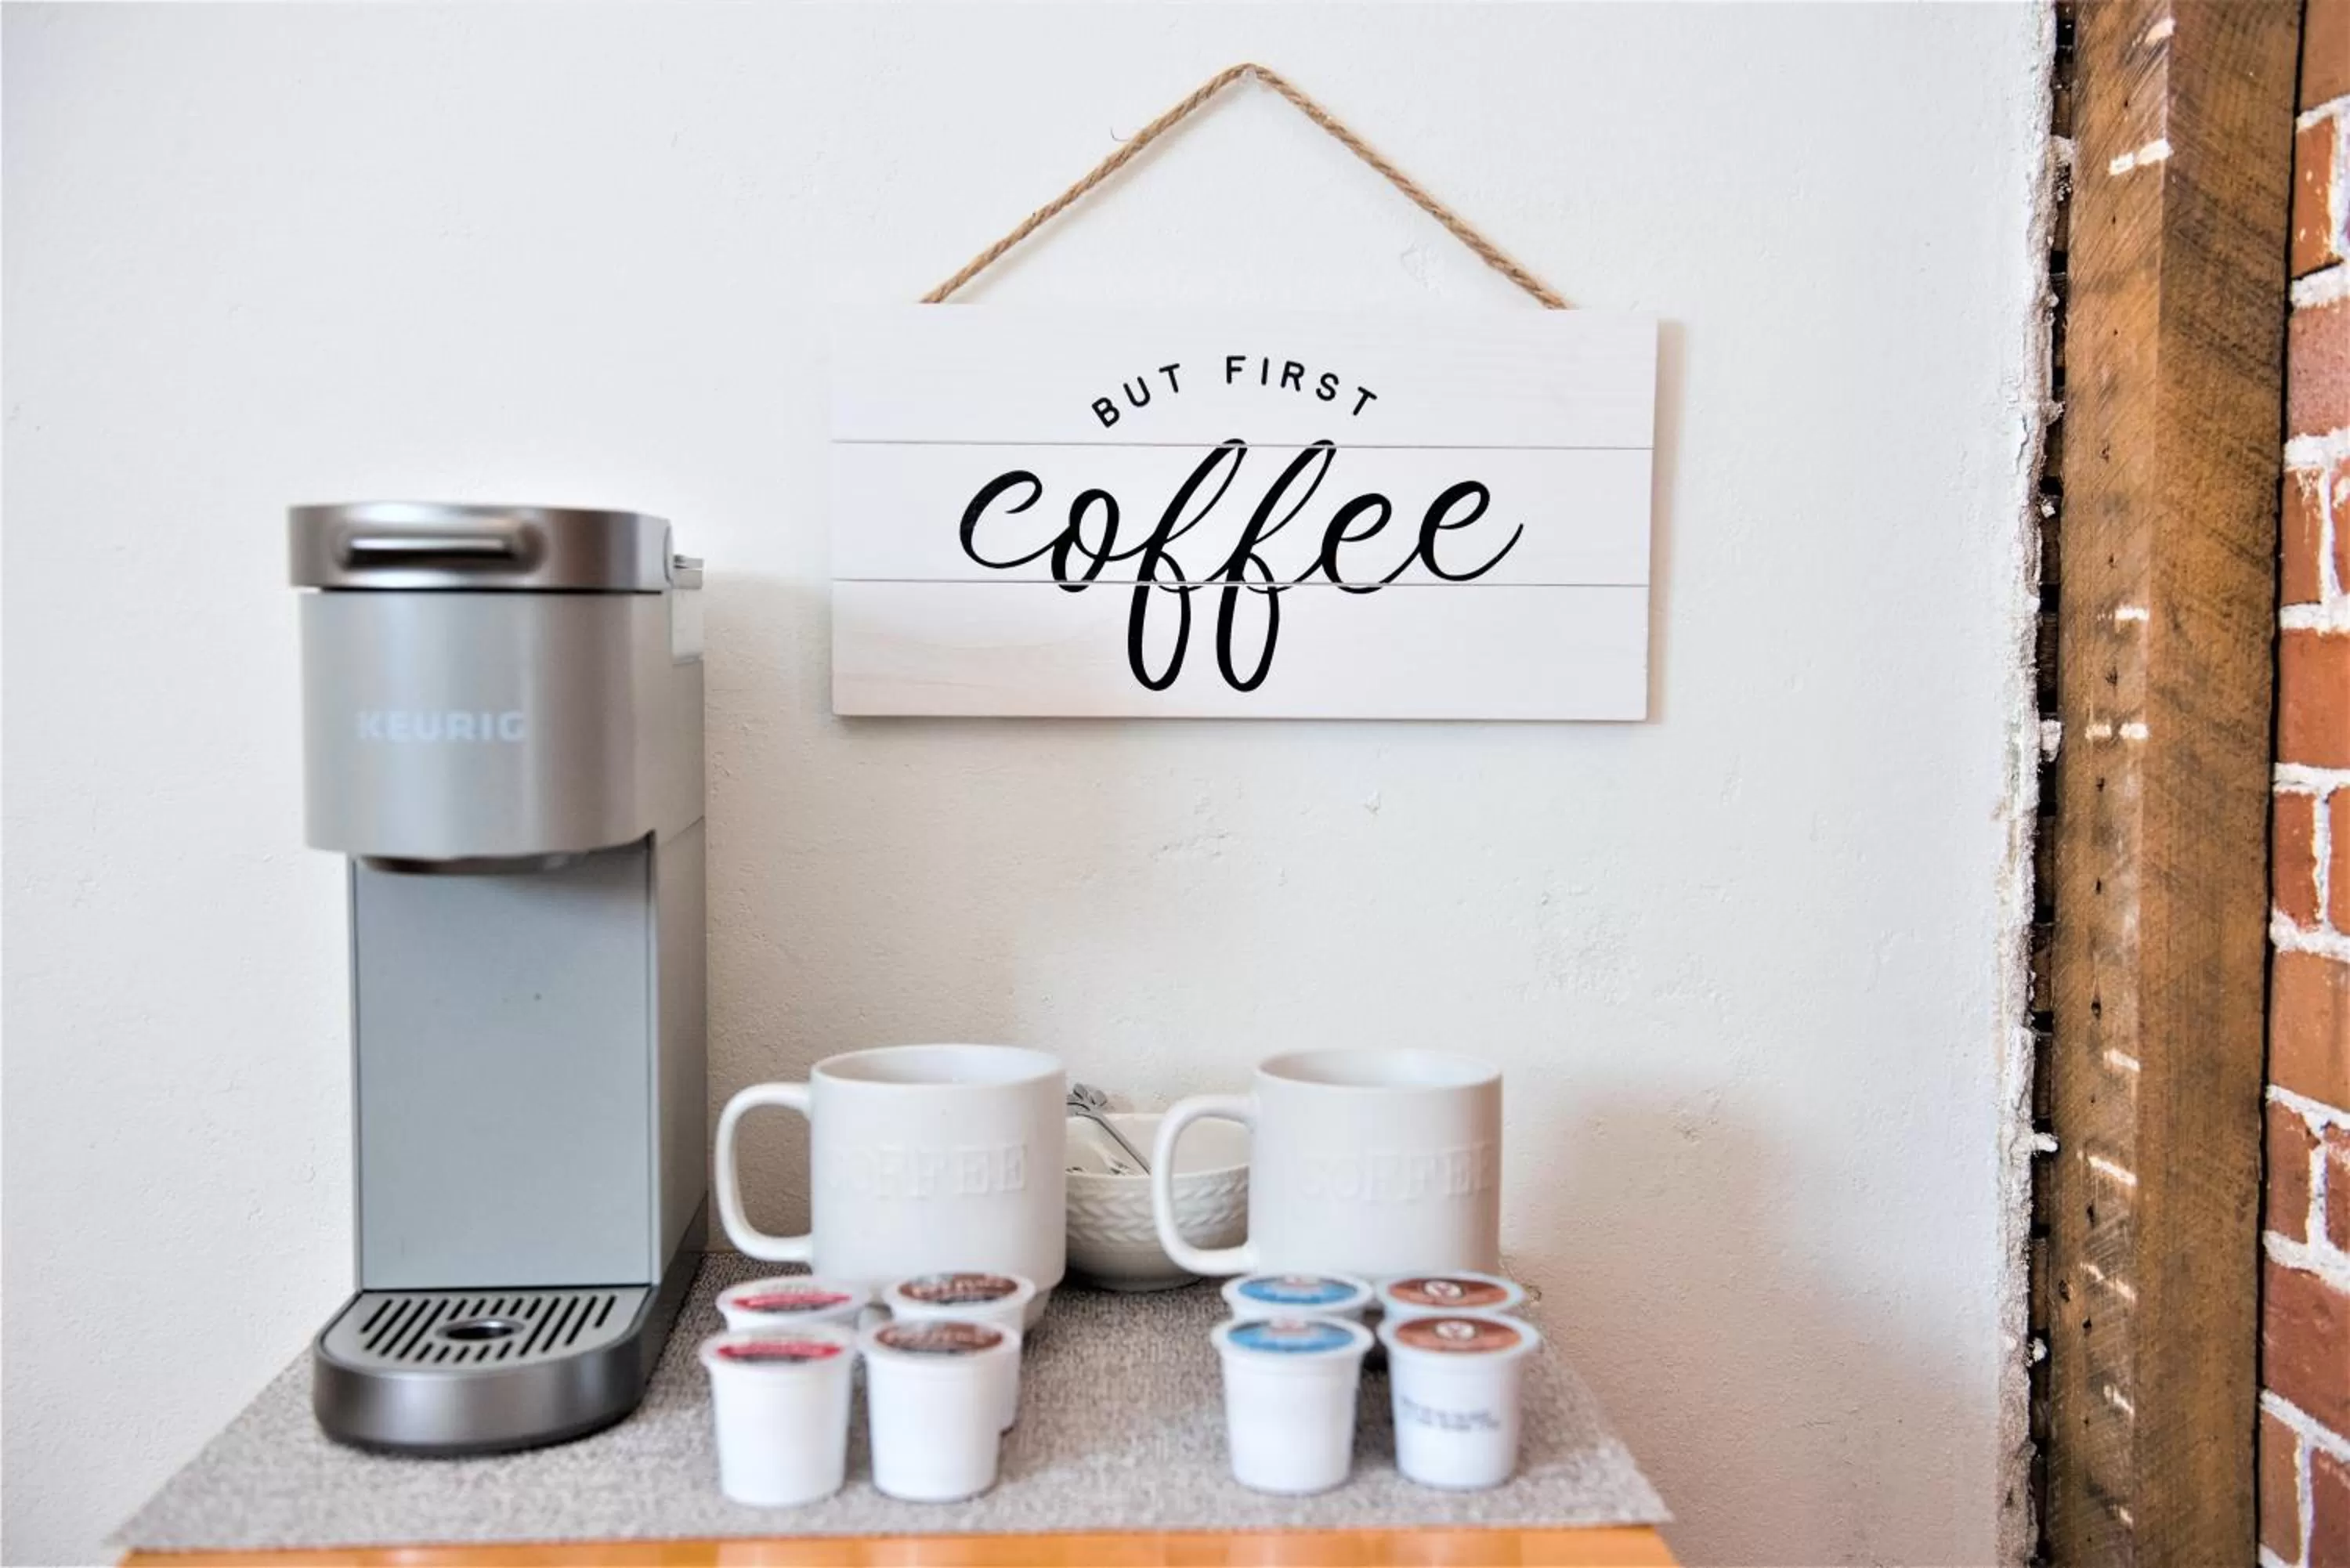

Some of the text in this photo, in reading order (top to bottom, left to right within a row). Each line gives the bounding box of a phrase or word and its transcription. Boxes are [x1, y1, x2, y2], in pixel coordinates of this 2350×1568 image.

[1092, 355, 1378, 428] BUT FIRST
[960, 439, 1524, 692] coffee
[356, 710, 527, 741] KEURIG
